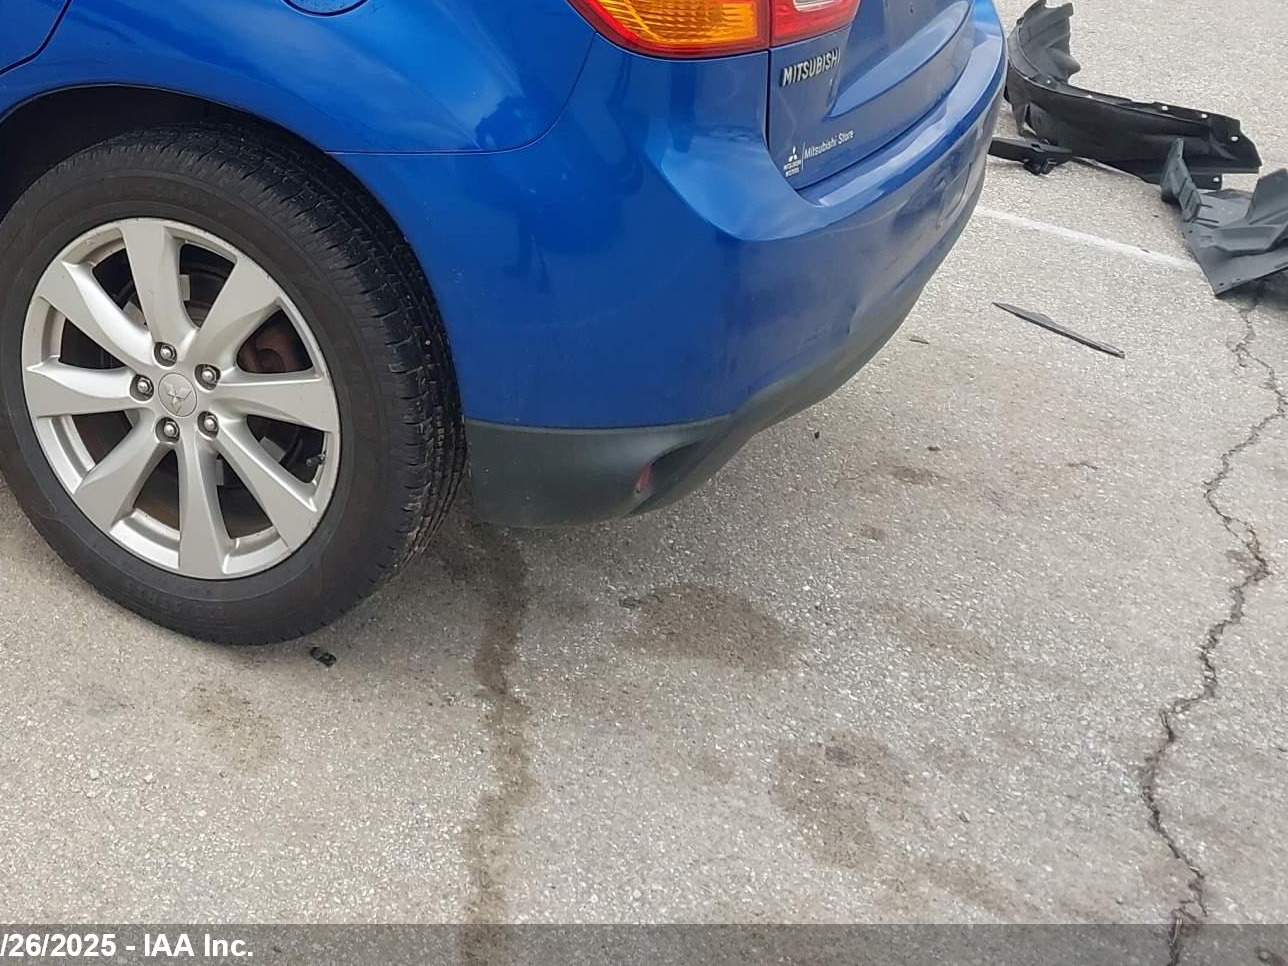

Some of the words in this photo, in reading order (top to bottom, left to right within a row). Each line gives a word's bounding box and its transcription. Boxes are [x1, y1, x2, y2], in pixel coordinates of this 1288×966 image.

[781, 48, 841, 86] MITSUBISHI
[804, 135, 837, 160] Mitsubishi
[838, 130, 854, 145] Store
